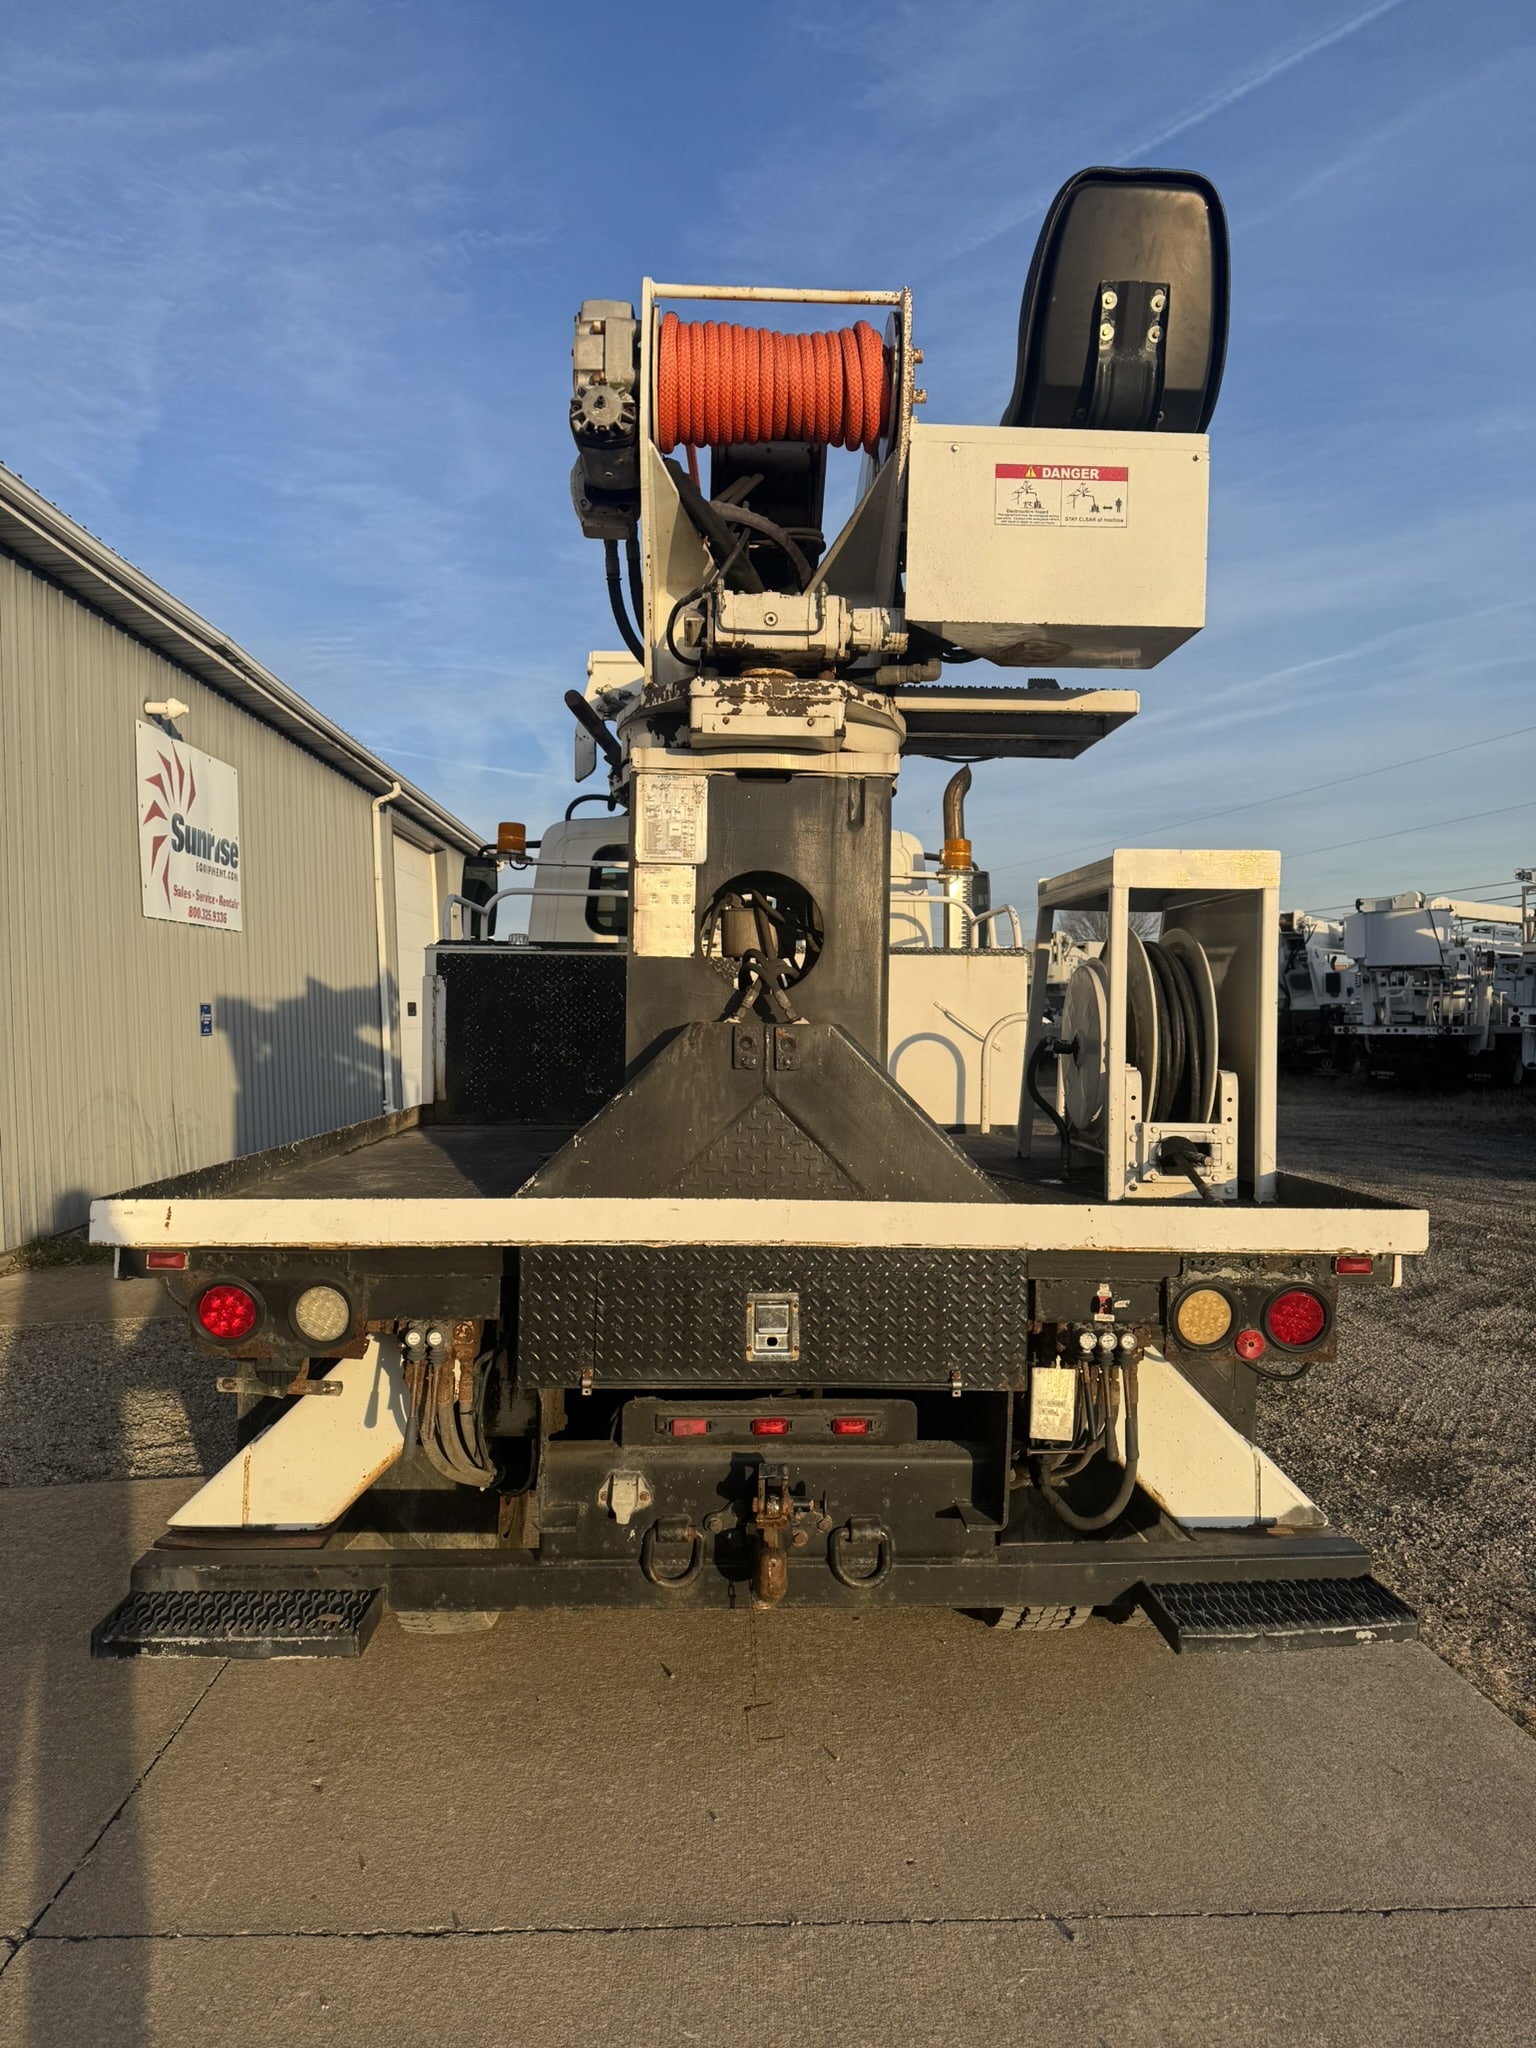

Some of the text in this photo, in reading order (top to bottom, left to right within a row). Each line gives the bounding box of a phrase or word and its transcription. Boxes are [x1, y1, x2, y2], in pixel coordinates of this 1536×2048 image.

[1042, 467, 1099, 480] DANGER
[171, 812, 239, 869] Sunrise
[196, 861, 239, 882] EQUIPMENT.COM
[173, 884, 239, 909] Sales Service Rentals
